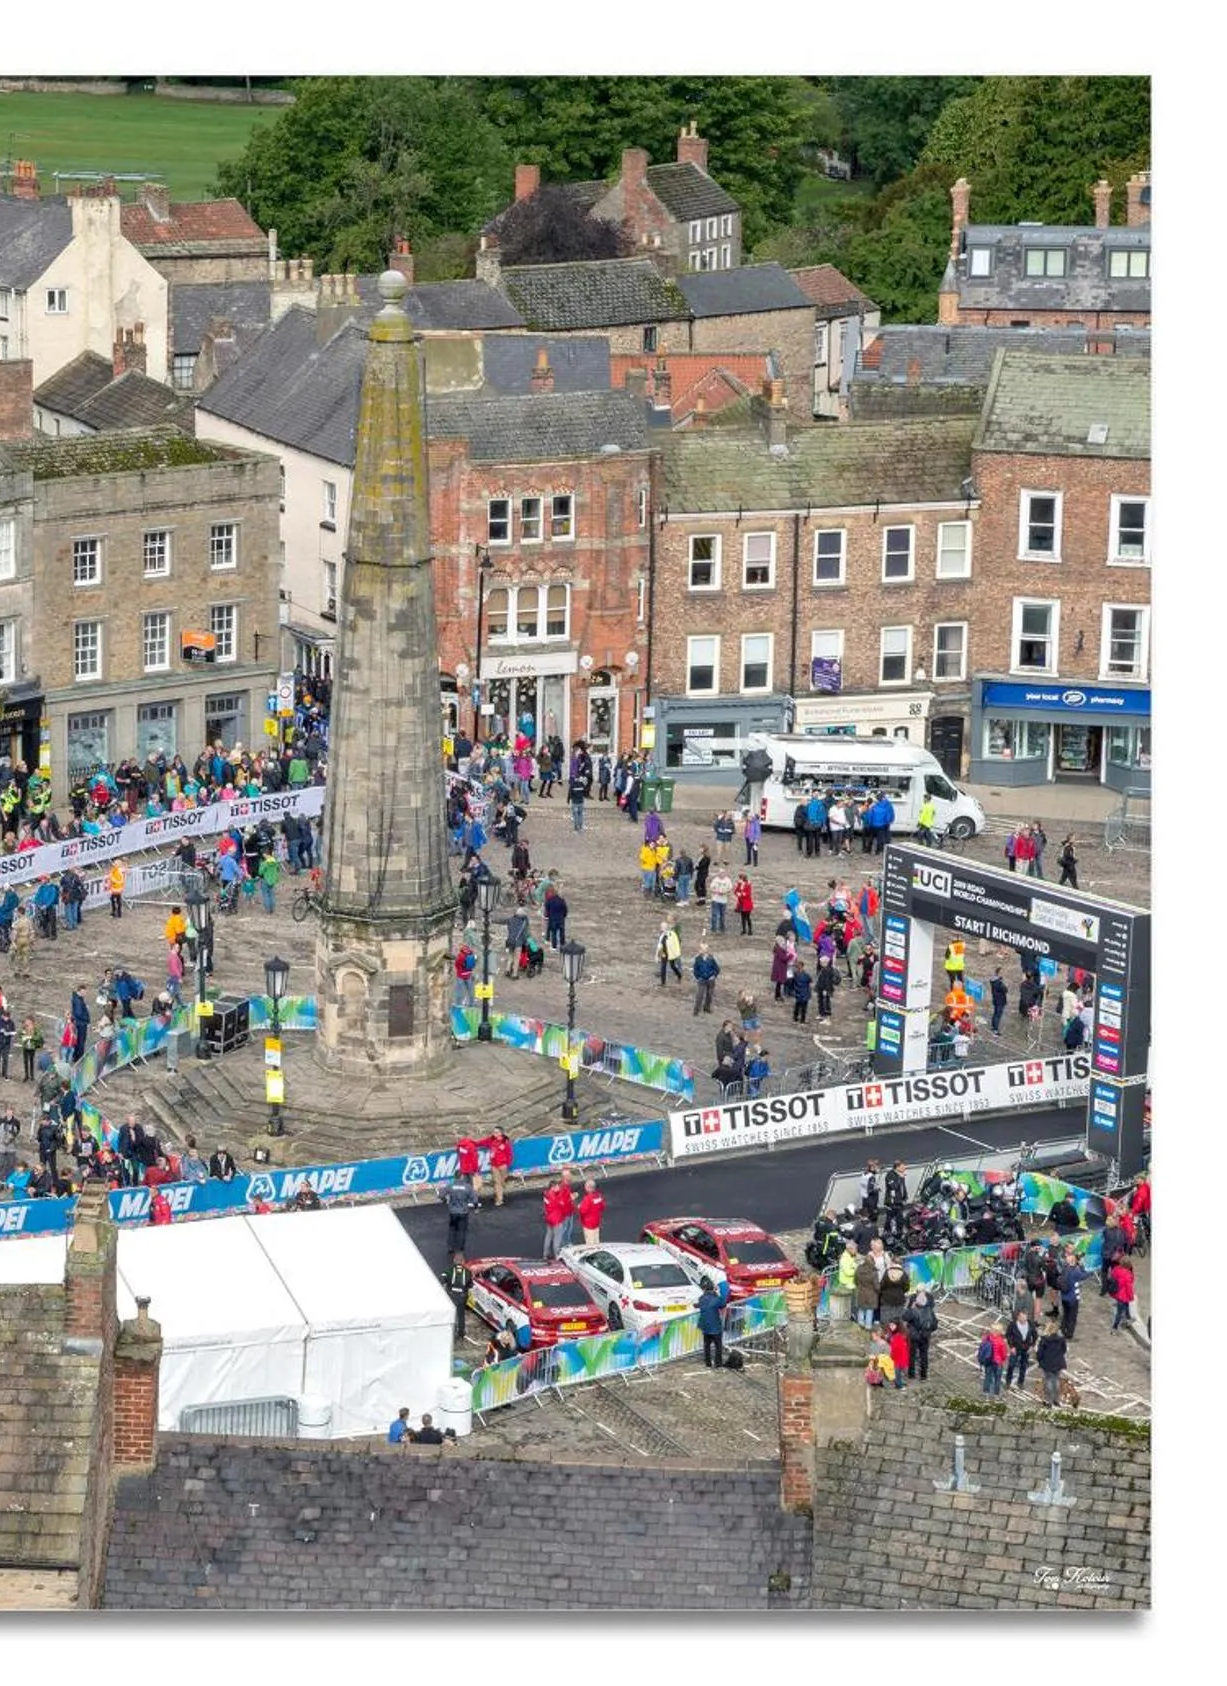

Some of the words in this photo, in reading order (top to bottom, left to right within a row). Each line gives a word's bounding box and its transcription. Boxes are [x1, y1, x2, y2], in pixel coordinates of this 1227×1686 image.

[252, 794, 300, 814] TISSOT
[162, 811, 205, 830] TISSOT
[79, 830, 121, 854] TISSOT
[920, 870, 948, 893] UCI
[953, 888, 975, 901] WORLD
[976, 895, 1028, 917] CHAMPIONSHIPS
[954, 915, 985, 934] START
[992, 926, 1050, 954] RICHMOND
[1045, 1056, 1090, 1081] TIS
[885, 1070, 985, 1104] TISSOT
[723, 1093, 825, 1130] TISSOT
[848, 1114, 879, 1127] SWISS
[884, 1106, 930, 1122] WATCHES
[936, 1101, 964, 1115] SINCE
[578, 1128, 641, 1158] MAPEI
[685, 1139, 717, 1153] SWISS
[719, 1131, 768, 1148] WATCHES
[774, 1124, 803, 1139] SINCE
[280, 1167, 357, 1199] MAPEI
